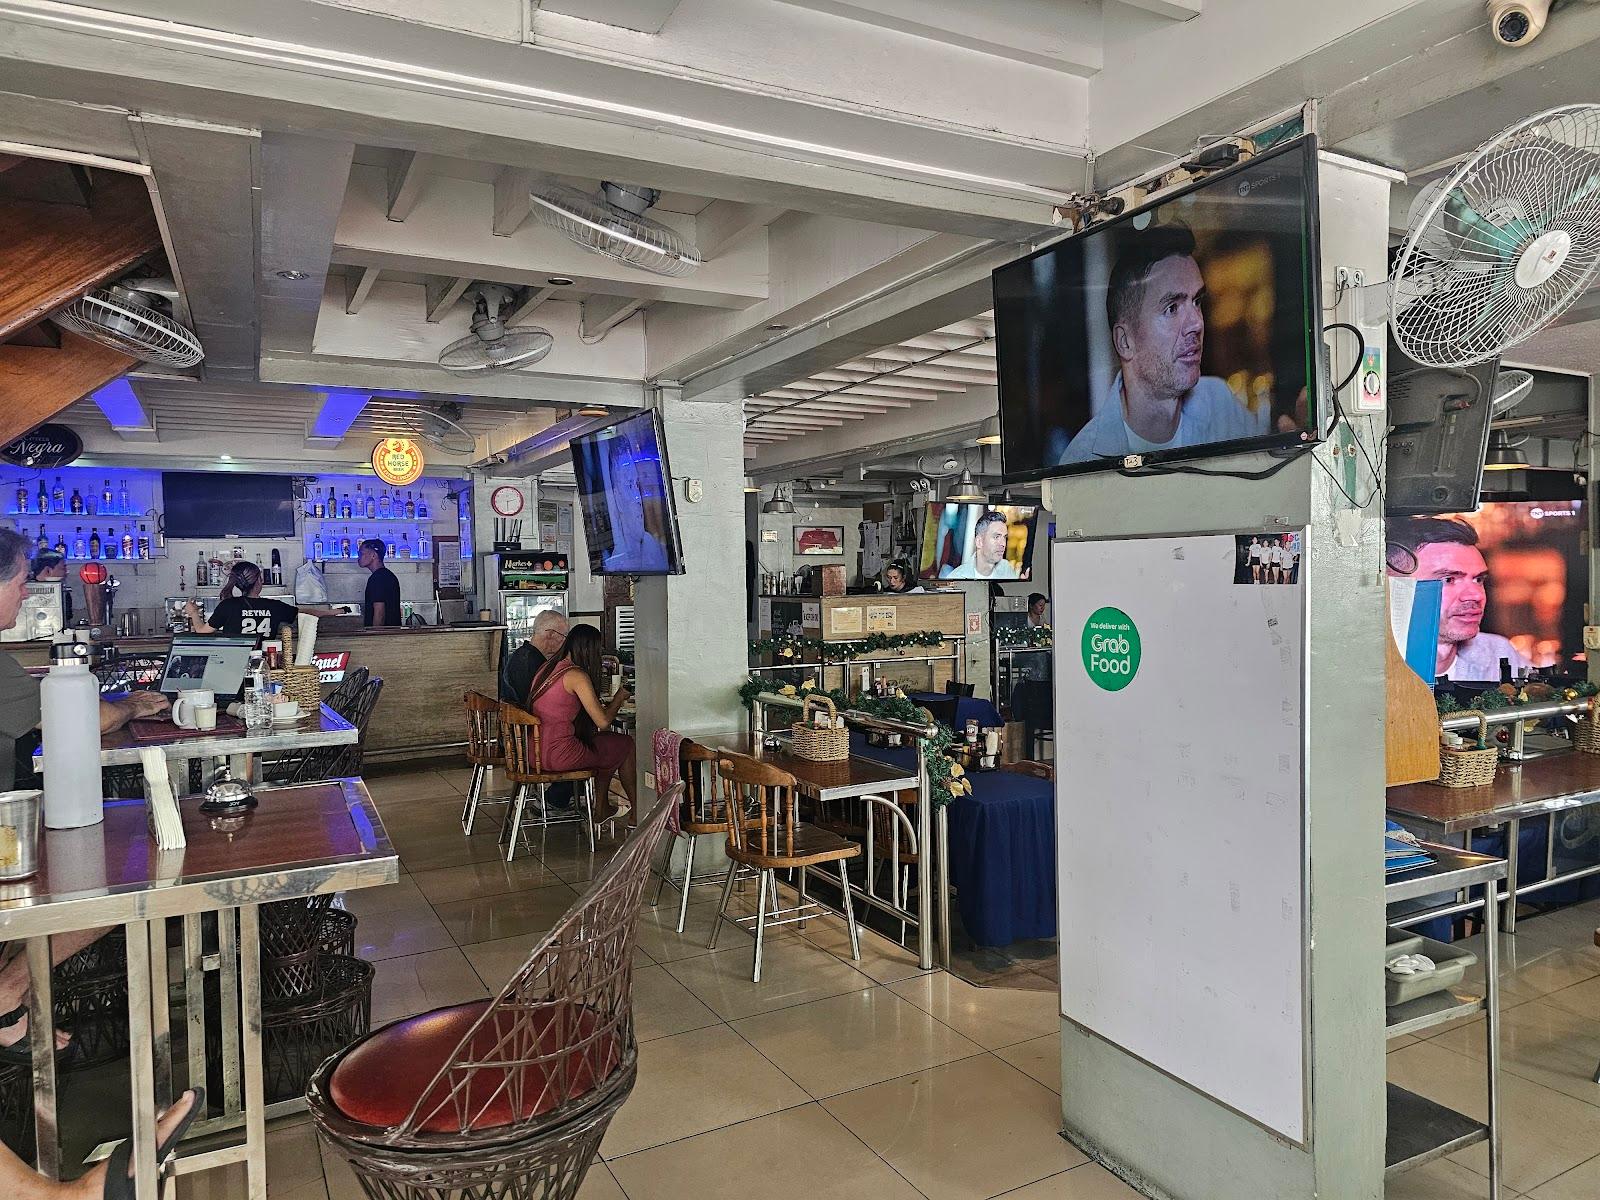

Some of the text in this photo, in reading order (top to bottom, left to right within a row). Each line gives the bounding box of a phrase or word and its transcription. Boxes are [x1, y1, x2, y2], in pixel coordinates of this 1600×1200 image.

[9, 440, 65, 458] Negra
[241, 609, 272, 617] REYNA
[241, 617, 272, 637] 24
[1099, 622, 1118, 630] deliver
[1118, 623, 1130, 631] with
[1091, 633, 1130, 655] Grab
[310, 652, 345, 670] iguel
[1090, 653, 1131, 675] Food
